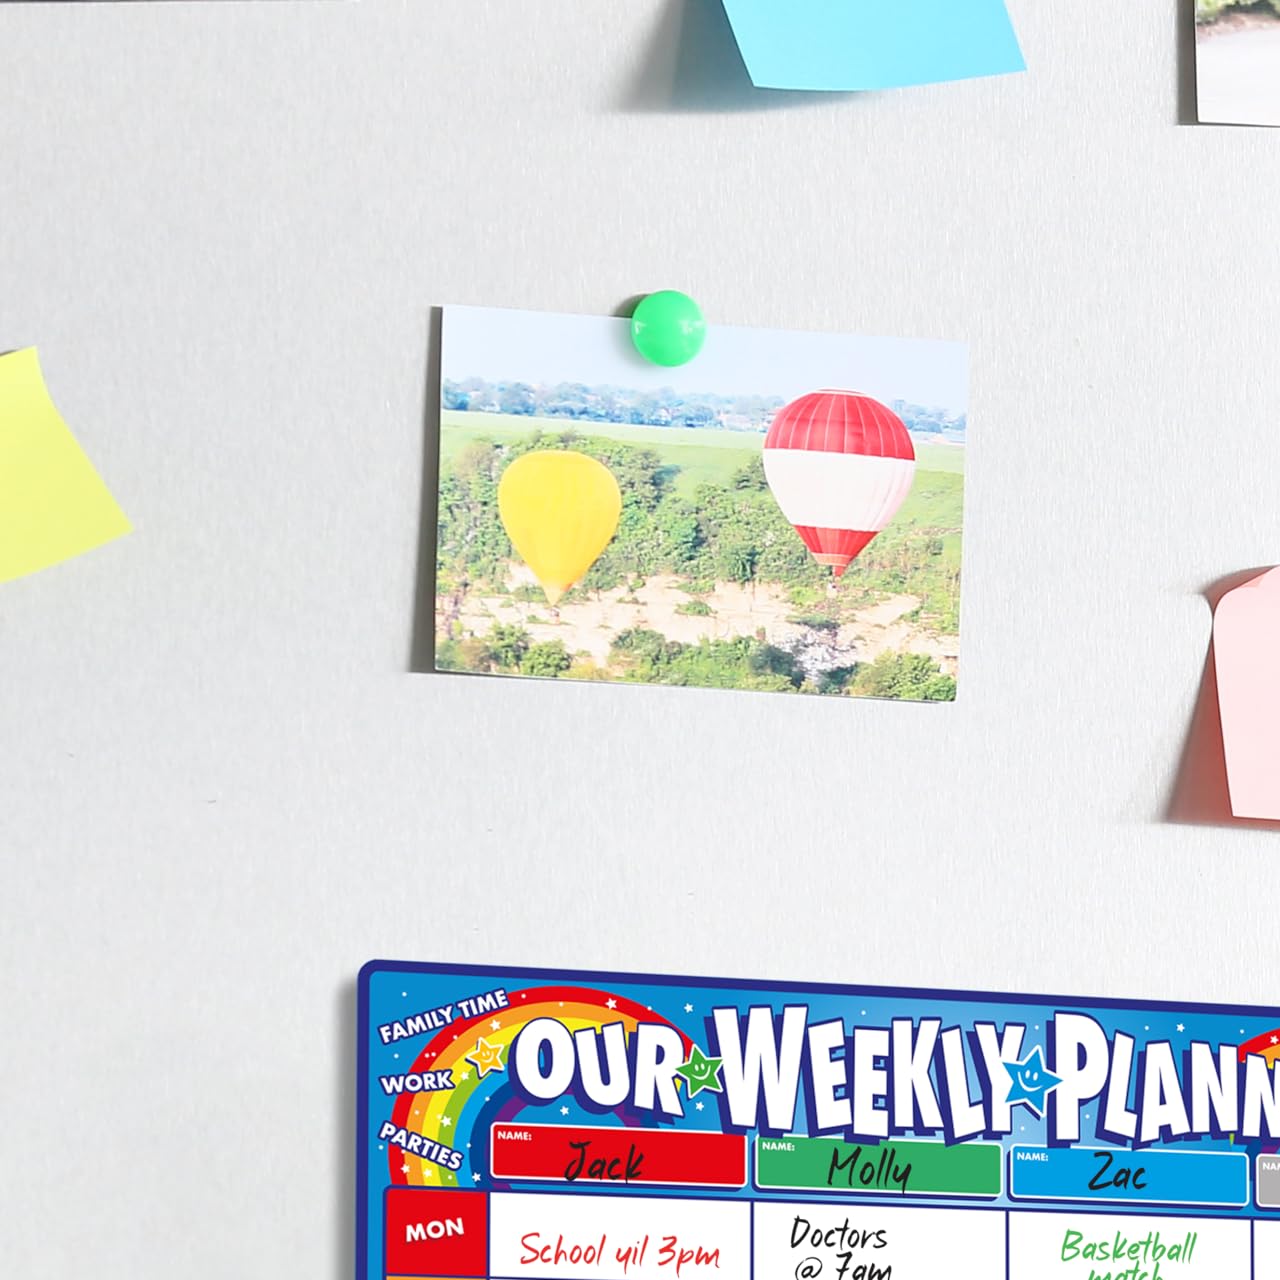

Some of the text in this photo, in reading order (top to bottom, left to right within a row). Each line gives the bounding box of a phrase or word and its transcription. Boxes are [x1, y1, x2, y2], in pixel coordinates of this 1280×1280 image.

[378, 988, 509, 1044] FAMILY TIME
[380, 1069, 455, 1094] WORK
[514, 1017, 685, 1117] OUR
[713, 1004, 1026, 1145] WEEKLY
[377, 1122, 464, 1171] PARTIES
[497, 1130, 532, 1141] NAME:
[762, 1141, 796, 1152] NAME:
[564, 1140, 646, 1183] Jack
[828, 1146, 912, 1193] Molly
[1016, 1152, 1049, 1162] NAME:
[1088, 1152, 1148, 1191] Zac
[405, 1217, 465, 1242] MON
[790, 1215, 888, 1252] Doctors
[1060, 1228, 1198, 1265] Basketball
[519, 1232, 606, 1266] School
[657, 1235, 720, 1278] 3pm
